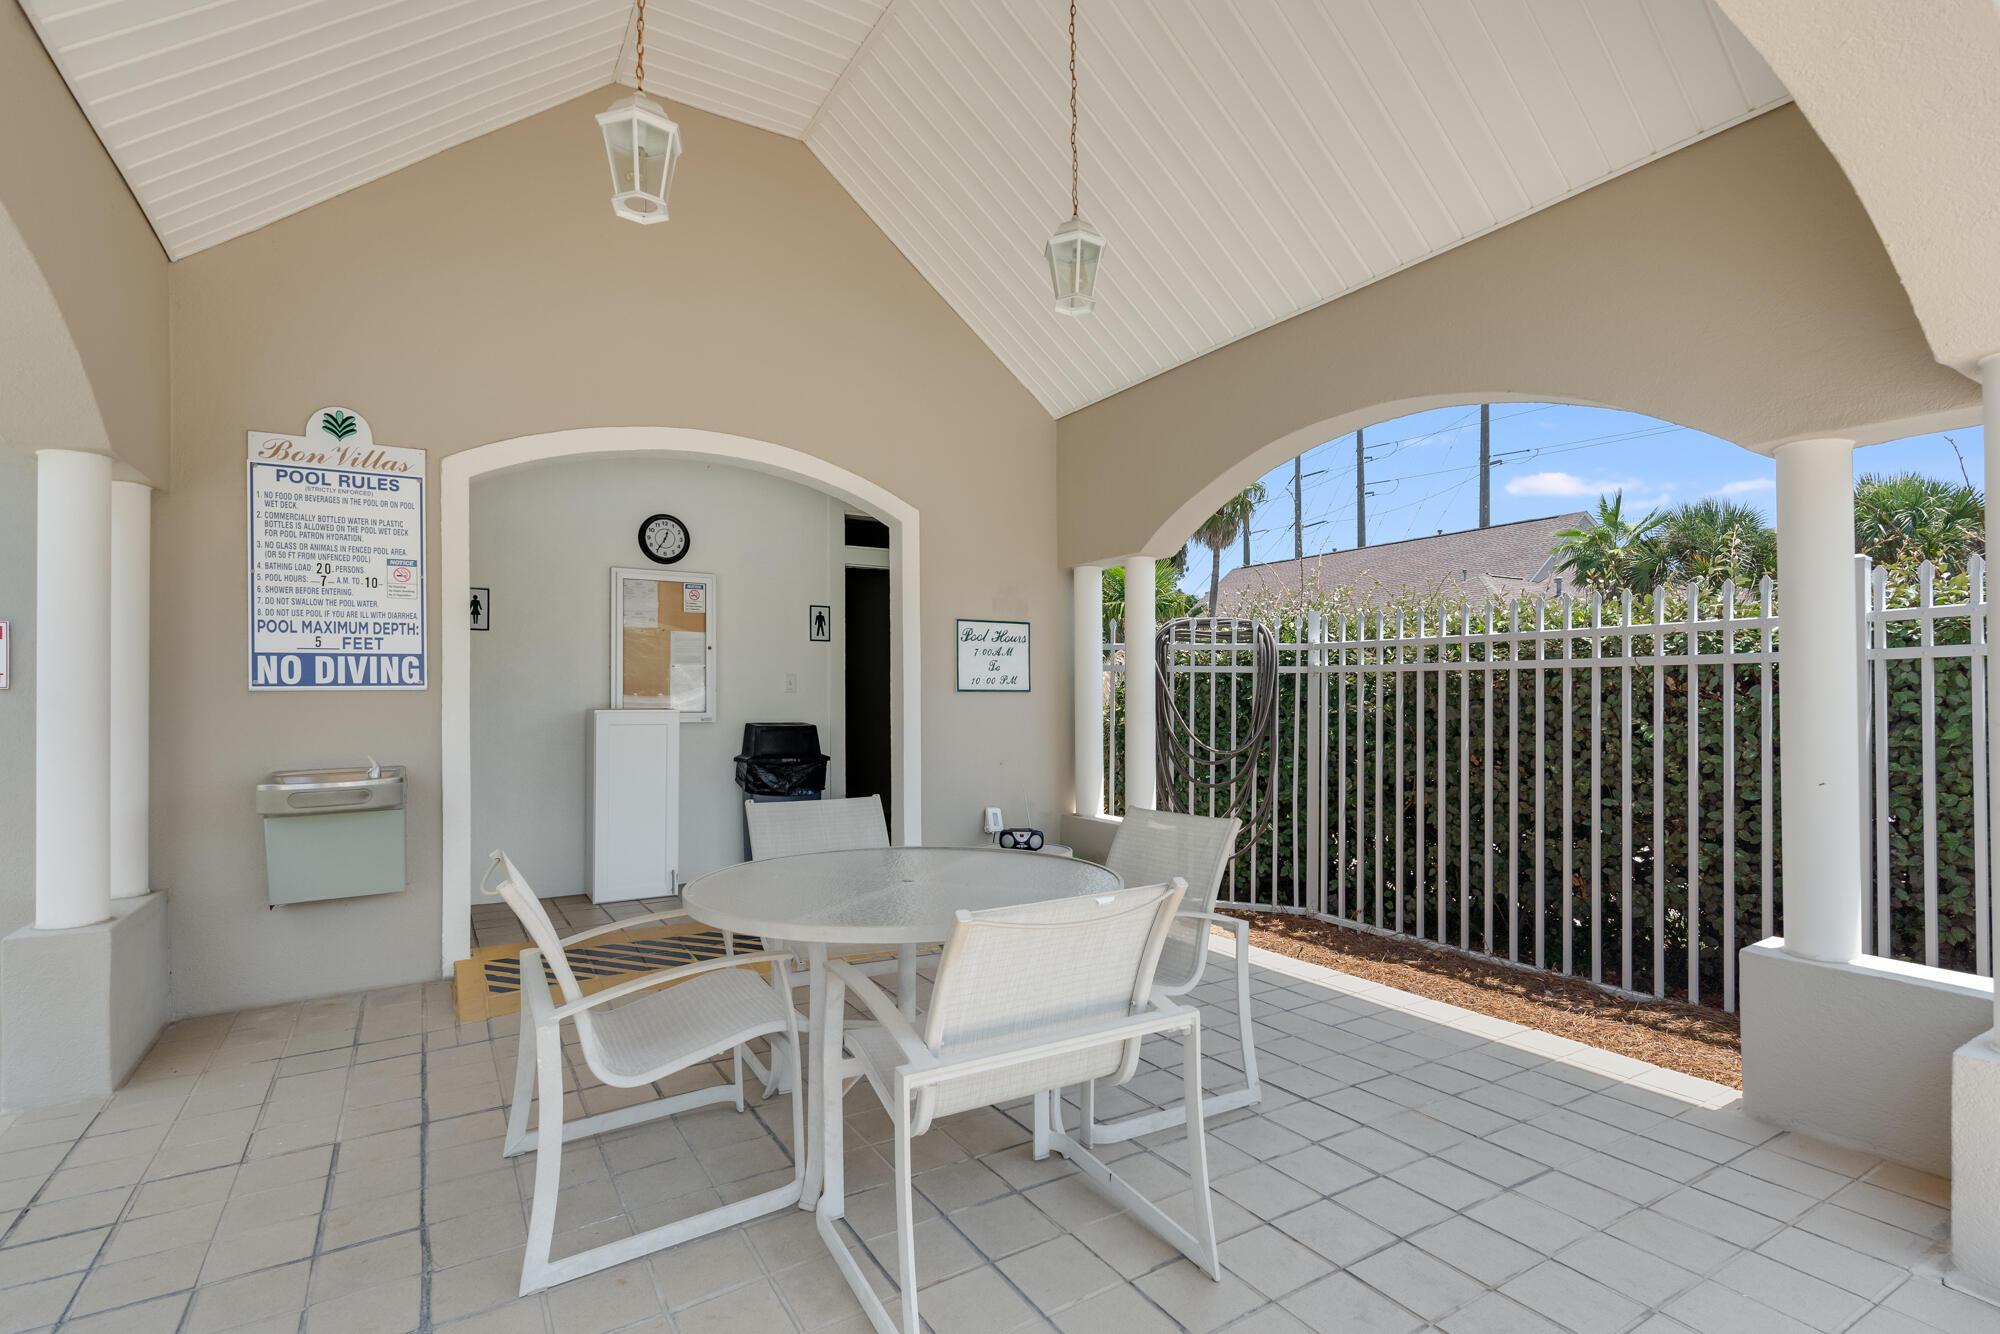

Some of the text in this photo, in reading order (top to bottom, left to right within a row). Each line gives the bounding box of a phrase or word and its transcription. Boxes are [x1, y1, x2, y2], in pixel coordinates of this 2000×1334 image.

[258, 438, 413, 472] Bon Villas
[276, 469, 400, 492] POOL RULES
[305, 486, 336, 494] (STRICTLY
[264, 491, 273, 499] NO
[275, 492, 292, 500] FOOD
[294, 493, 303, 501] OR
[305, 494, 340, 504] BEVERAGES
[363, 499, 378, 507] POOL
[380, 500, 388, 508] OR
[400, 502, 415, 510] POOL
[264, 520, 293, 529] BOTTLES
[304, 523, 334, 531] ALLOWED
[265, 512, 315, 522] COMMERCIALLY
[318, 515, 346, 524] BOTTLED
[379, 520, 403, 528] PLASTIC
[265, 529, 278, 537] FOR
[280, 530, 297, 538] POOL
[300, 531, 324, 540] PATRON
[276, 542, 297, 550] GLASS
[310, 544, 338, 552] ANIMALS
[348, 546, 371, 554] FENCED
[373, 547, 389, 555] POOL
[265, 551, 276, 559] (OR
[298, 552, 316, 560] FROM
[318, 553, 350, 561] UNFENCED
[353, 555, 370, 564] POOL)
[265, 562, 292, 570] BATHING
[316, 563, 331, 574] 20
[321, 576, 326, 586] 7
[365, 577, 377, 588] 10
[295, 586, 319, 594] BEFORE
[291, 598, 323, 606] SWALLOW
[291, 609, 304, 617] USE
[257, 620, 419, 635] POOL MAXIMUM DEPTH:
[961, 627, 1026, 643] Pool Hours
[315, 636, 384, 650] 5 FEET
[257, 654, 420, 685] NO DIVING
[988, 660, 1000, 671] To
